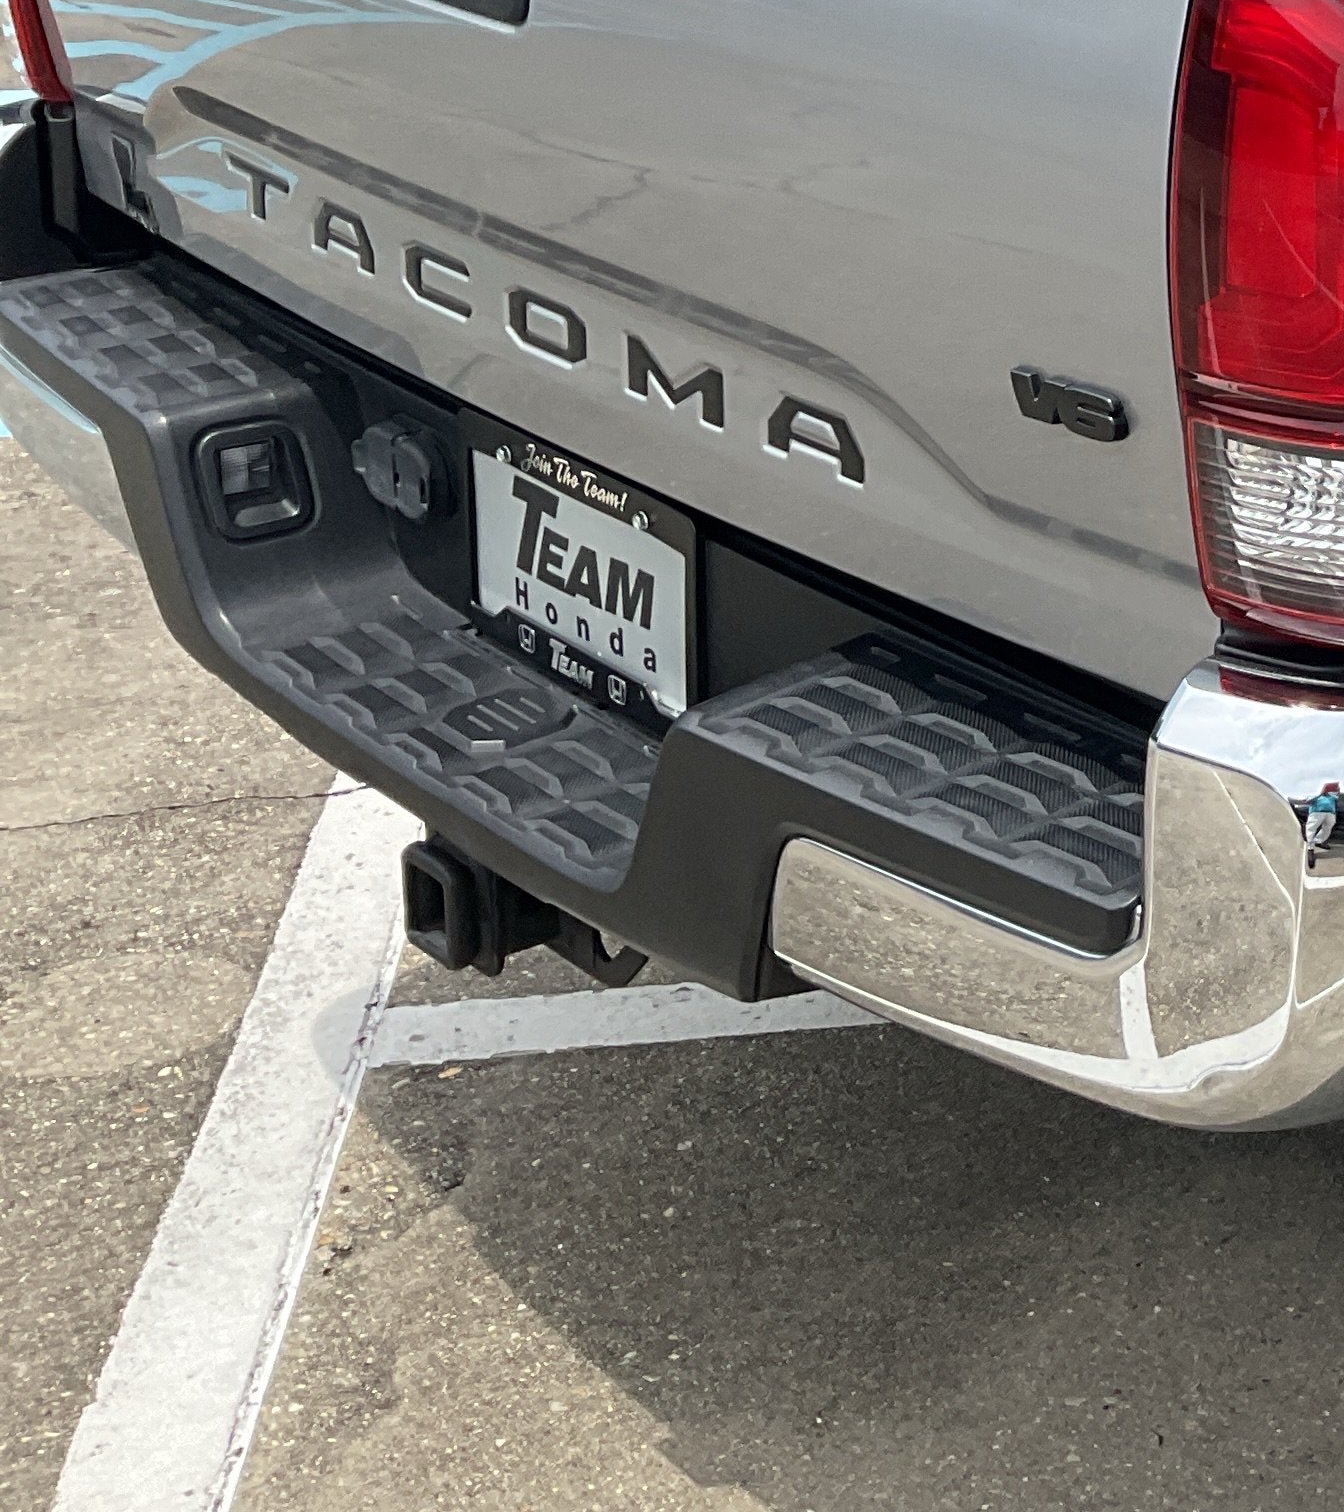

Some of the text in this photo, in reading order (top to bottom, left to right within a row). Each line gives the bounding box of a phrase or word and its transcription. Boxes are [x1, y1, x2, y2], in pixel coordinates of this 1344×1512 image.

[224, 149, 866, 489] TACOMA
[1010, 366, 1130, 442] V6
[520, 443, 628, 512] Join The Team!
[512, 475, 655, 630] TEAM
[515, 576, 657, 673] Honda
[549, 638, 595, 690] TEAM
